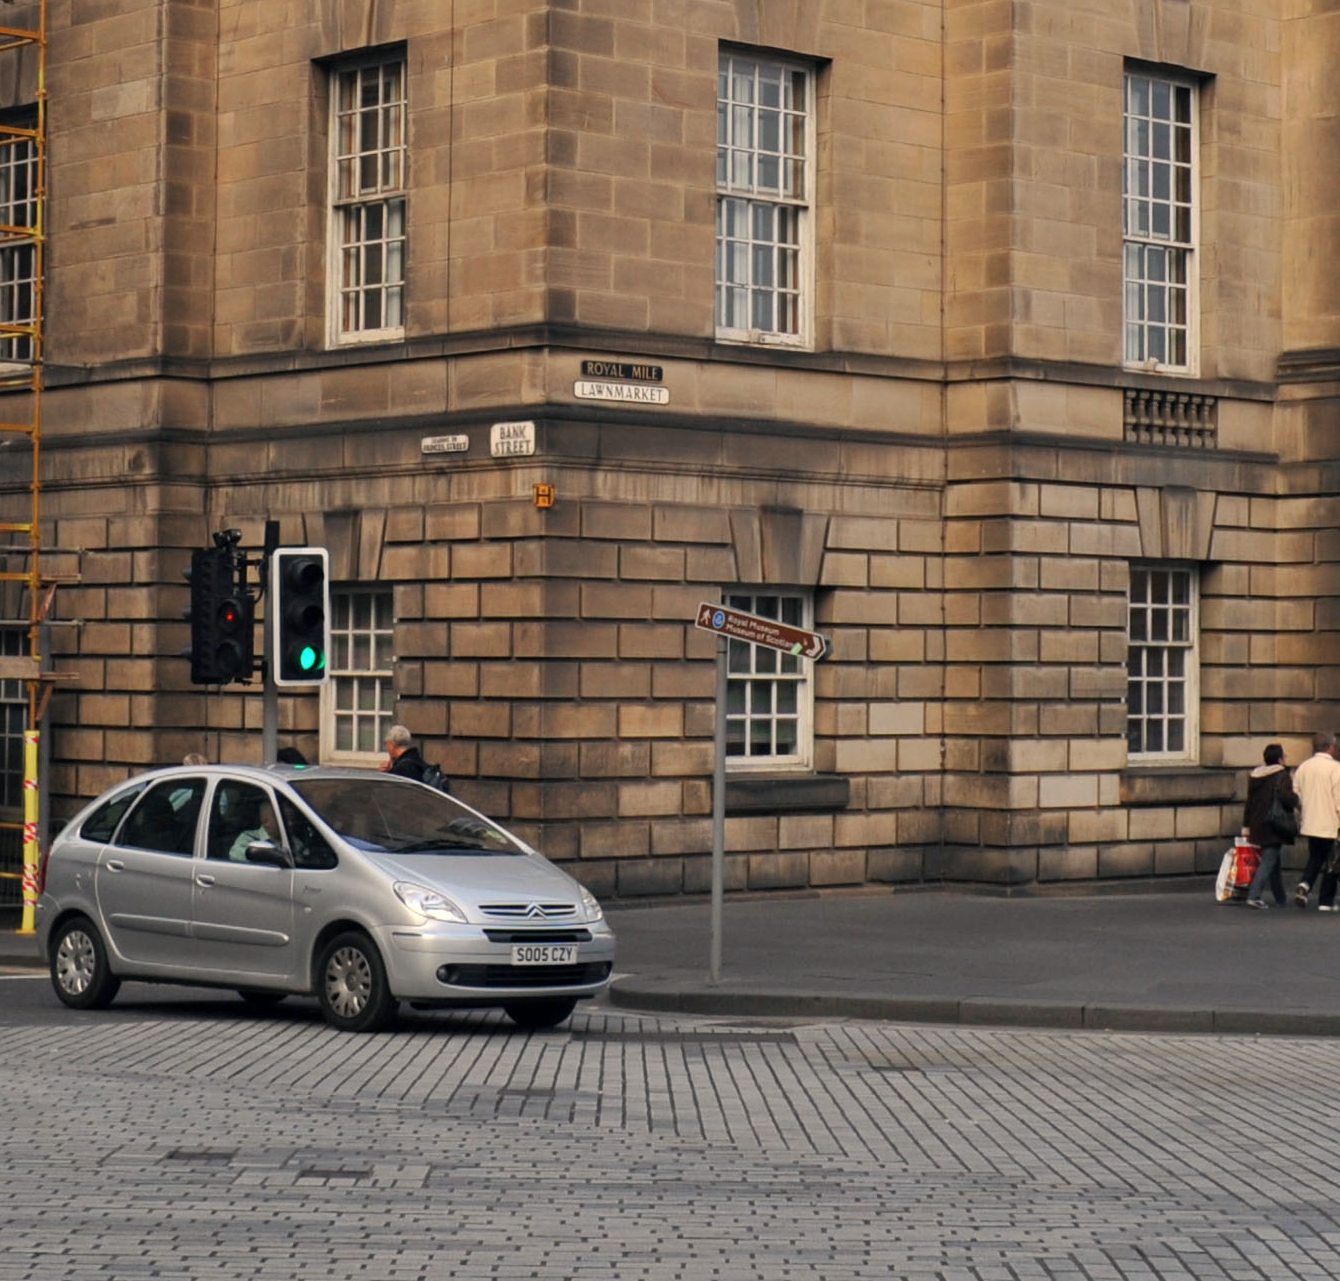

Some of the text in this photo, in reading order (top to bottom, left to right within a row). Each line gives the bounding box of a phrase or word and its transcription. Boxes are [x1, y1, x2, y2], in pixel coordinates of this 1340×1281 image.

[587, 362, 659, 380] ROYAL MILE
[581, 383, 664, 401] LAWNMARKET
[500, 425, 527, 439] BANK
[494, 439, 531, 455] STREET
[728, 615, 780, 636] Royal Museum
[726, 623, 756, 638] Museum
[766, 634, 794, 649] Scotlan
[551, 947, 573, 962] CZY
